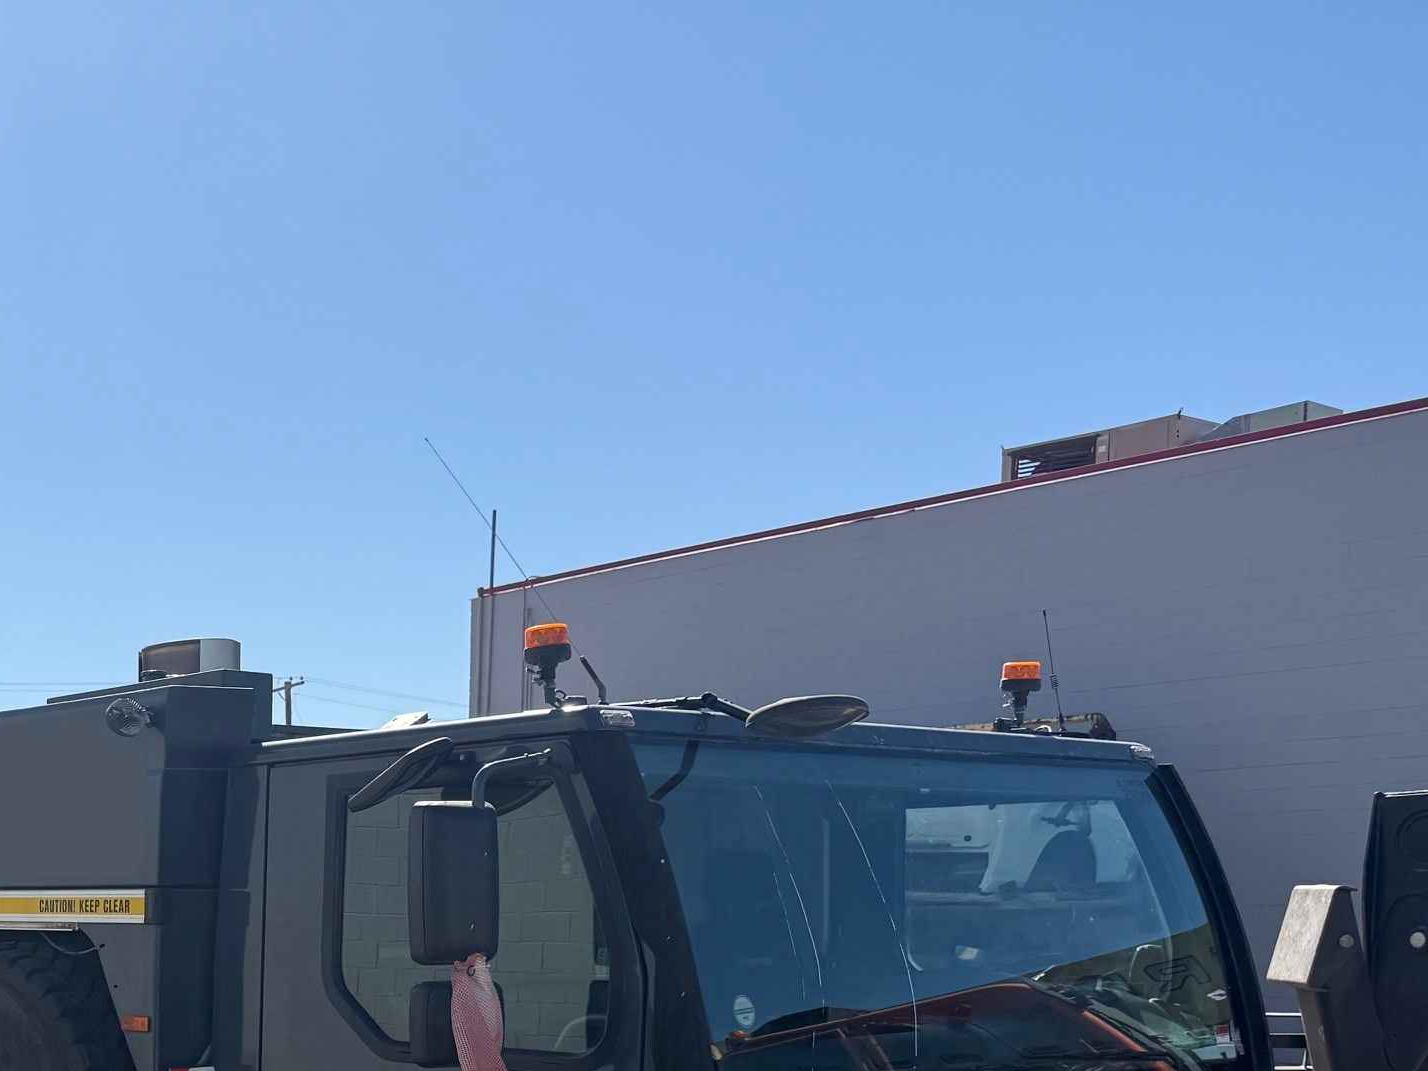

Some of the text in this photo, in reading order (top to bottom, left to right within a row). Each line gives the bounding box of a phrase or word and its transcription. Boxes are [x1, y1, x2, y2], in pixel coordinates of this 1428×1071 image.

[39, 899, 130, 913] CAUTION! KEEP CLEAR
